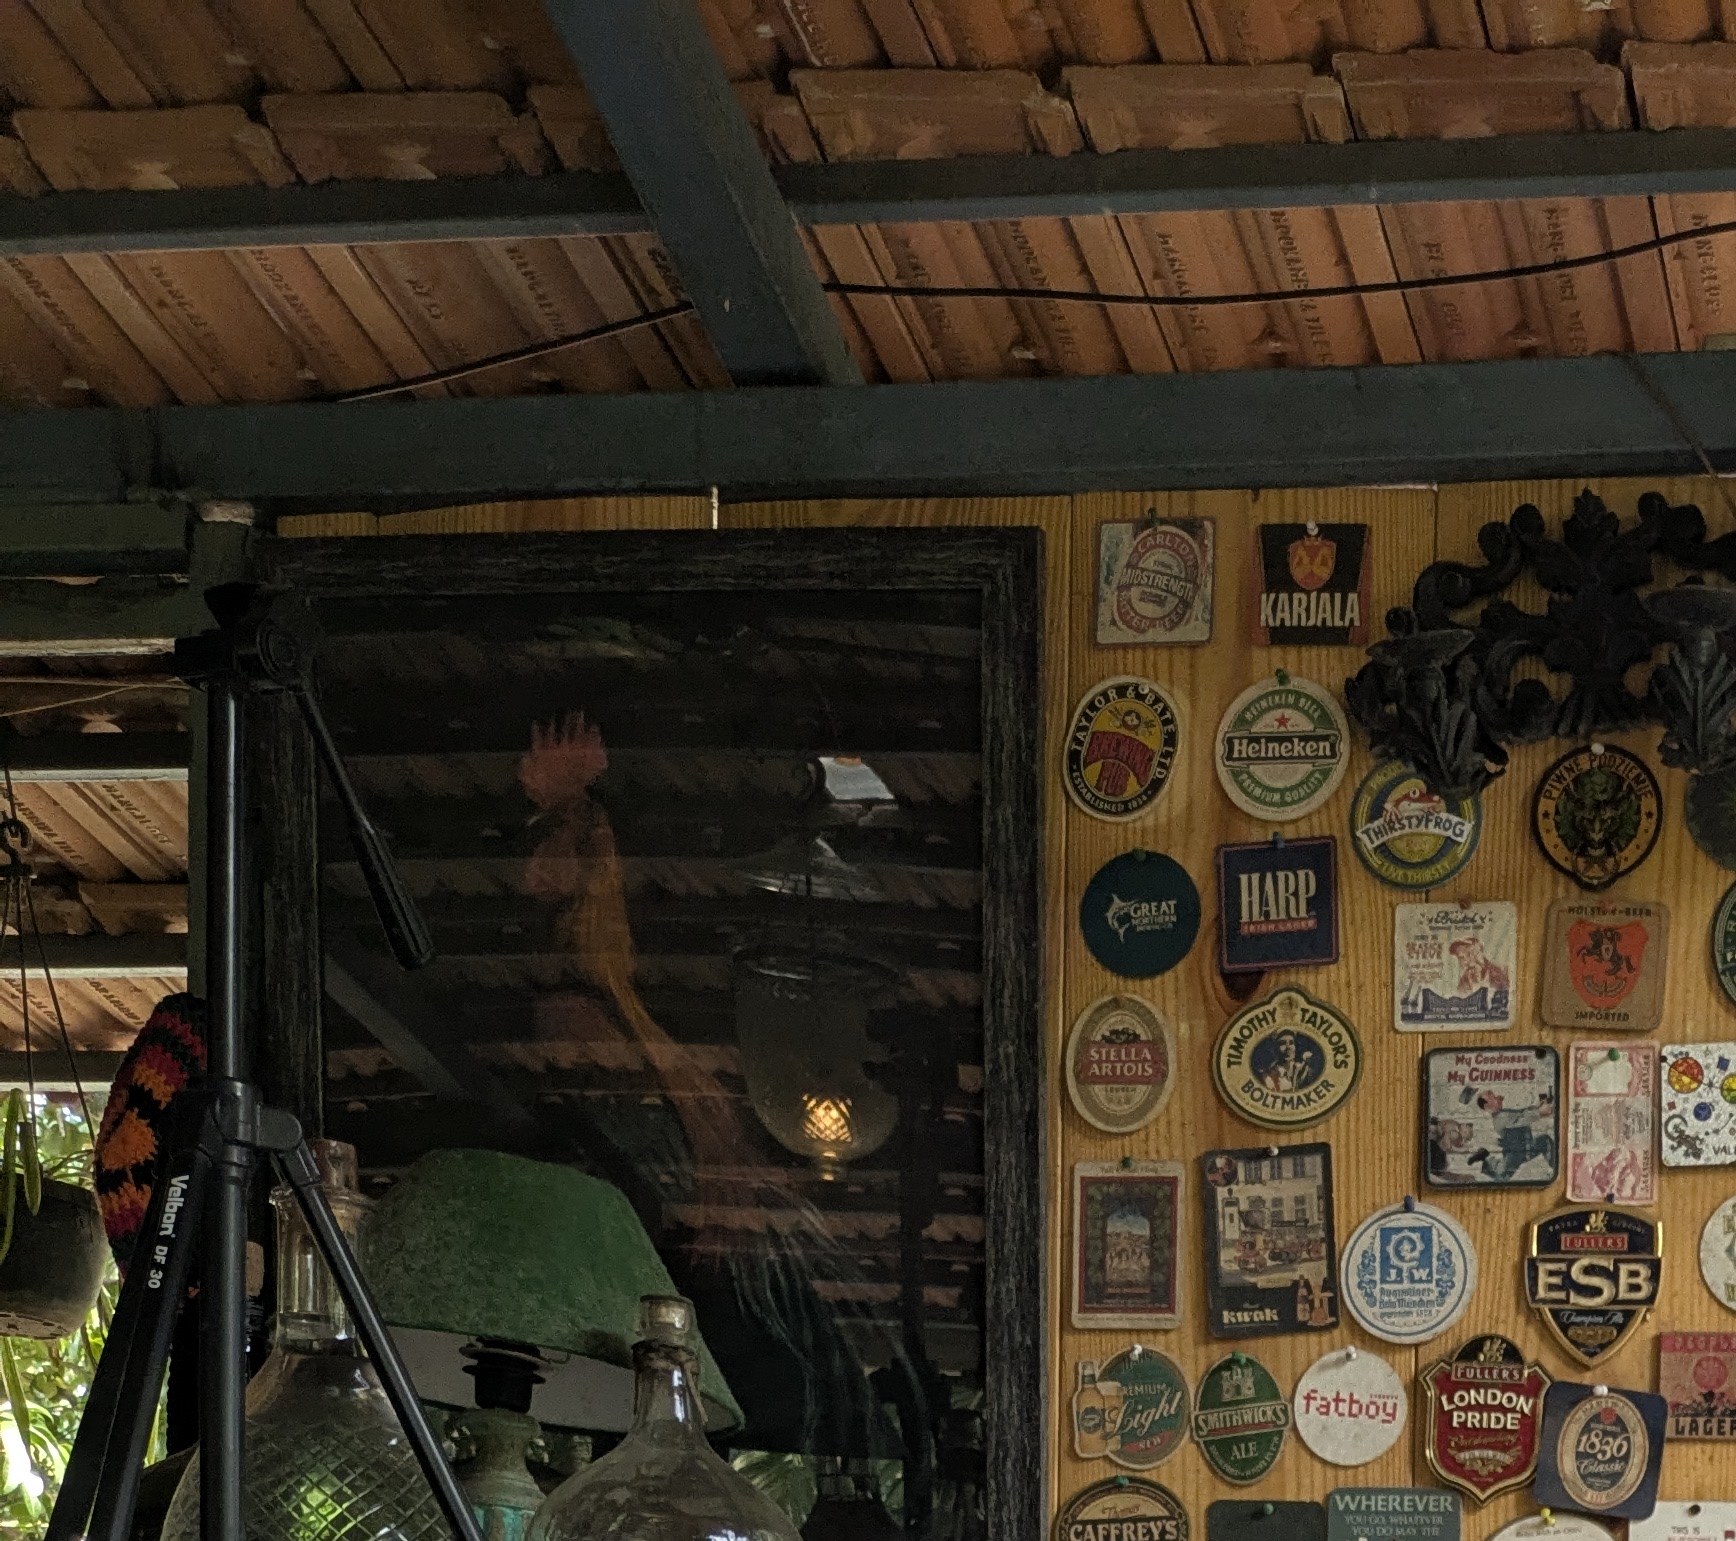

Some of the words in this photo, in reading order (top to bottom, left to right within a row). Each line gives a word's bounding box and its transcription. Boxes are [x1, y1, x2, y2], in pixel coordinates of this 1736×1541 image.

[1261, 592, 1361, 626] KARJALA
[1072, 689, 1117, 750] TAYLOR
[1232, 737, 1332, 758] Heineken
[1361, 811, 1465, 844] THIRSTYFROG
[1130, 900, 1177, 917] GREAT
[1239, 869, 1316, 922] HARP
[1227, 1007, 1278, 1068] TIMOTHY
[1089, 1049, 1152, 1061] STELLA
[1089, 1062, 1152, 1076] ARTOIS
[1241, 1077, 1336, 1111] BOLTMAKER
[159, 1175, 189, 1236] Velbon
[154, 1246, 168, 1264] DF
[148, 1270, 163, 1288] 30
[1536, 1257, 1652, 1306] ESB
[1302, 1390, 1398, 1424] fatboy
[1441, 1389, 1533, 1415] LONDON
[1452, 1410, 1521, 1429] PRIDE
[1577, 1431, 1628, 1461] 1836
[1335, 1494, 1453, 1512] WHEREVER
